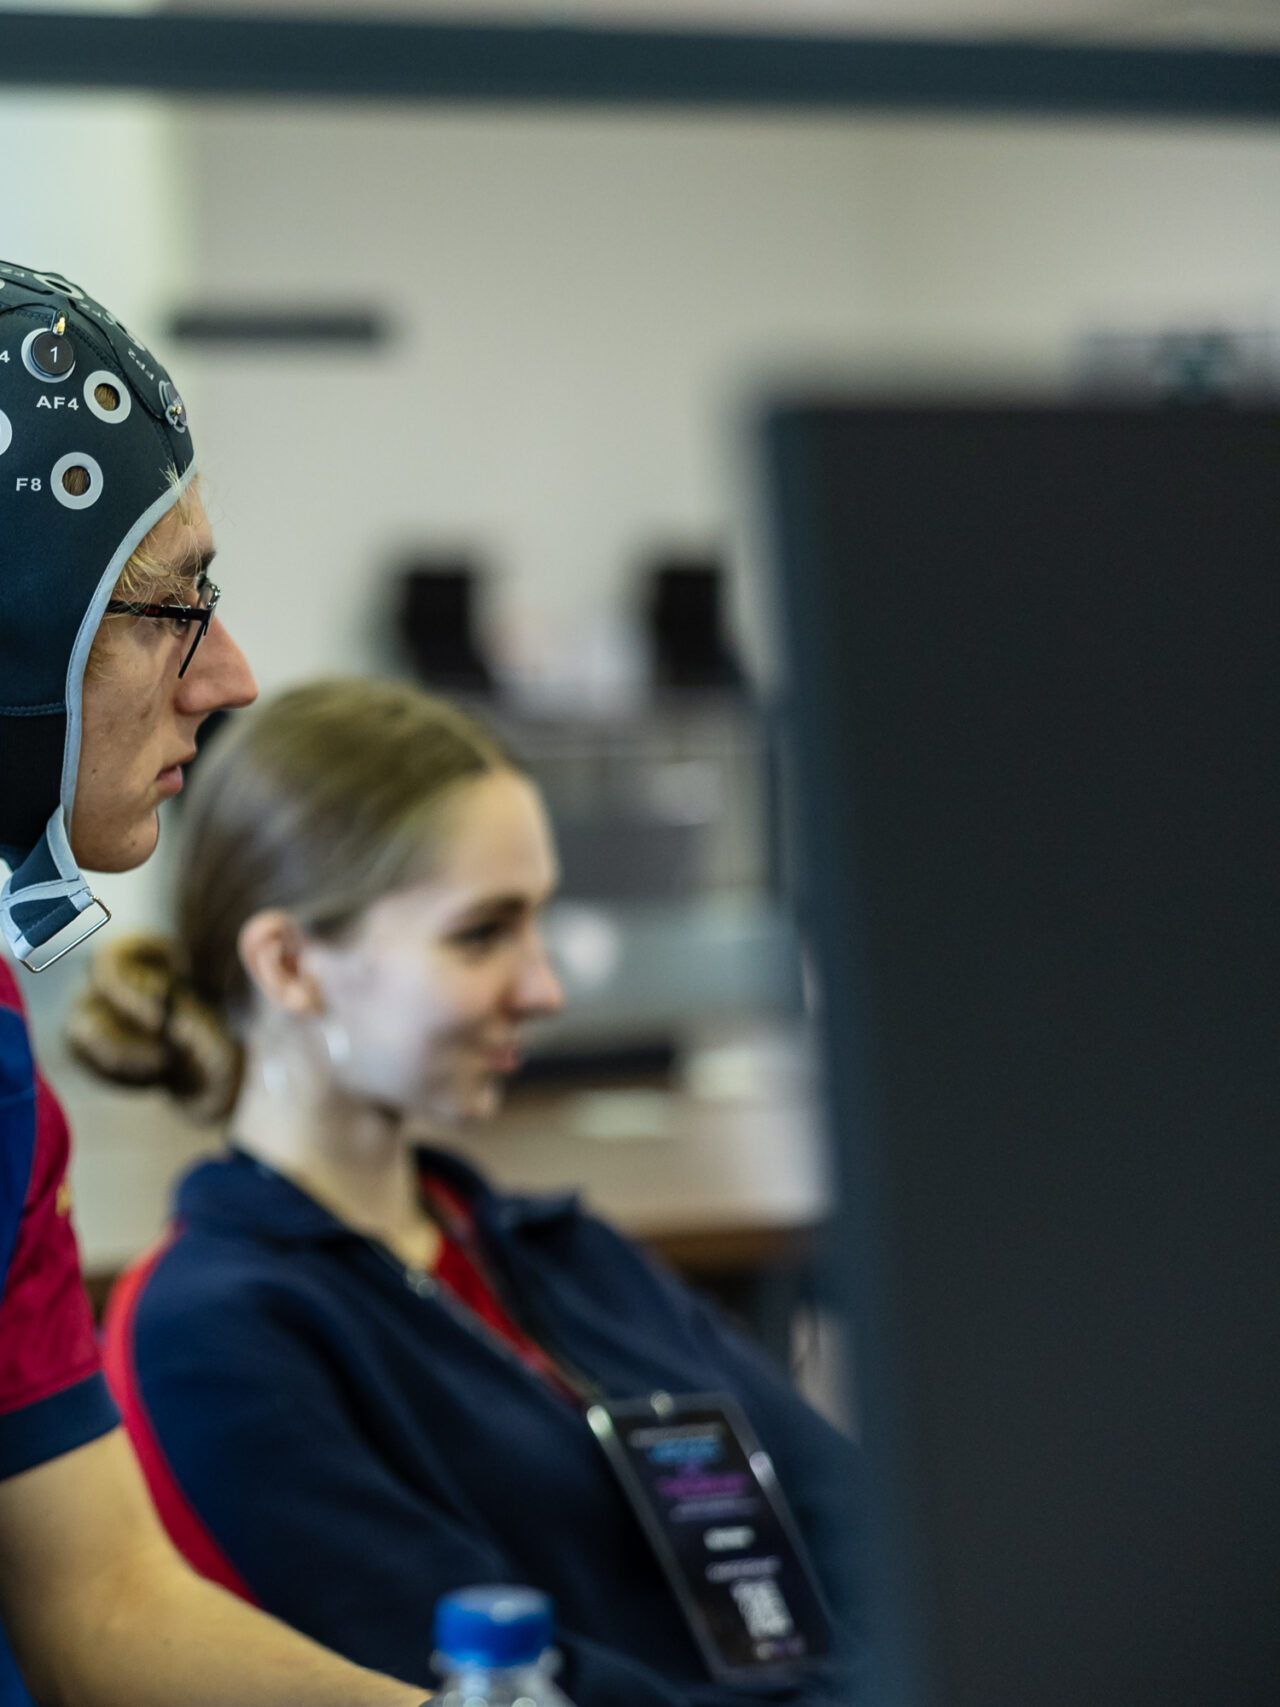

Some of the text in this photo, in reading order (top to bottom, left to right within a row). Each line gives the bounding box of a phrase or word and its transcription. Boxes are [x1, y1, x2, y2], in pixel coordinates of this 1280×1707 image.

[49, 345, 58, 363] 1
[36, 395, 80, 411] AF4
[15, 477, 42, 492] F8
